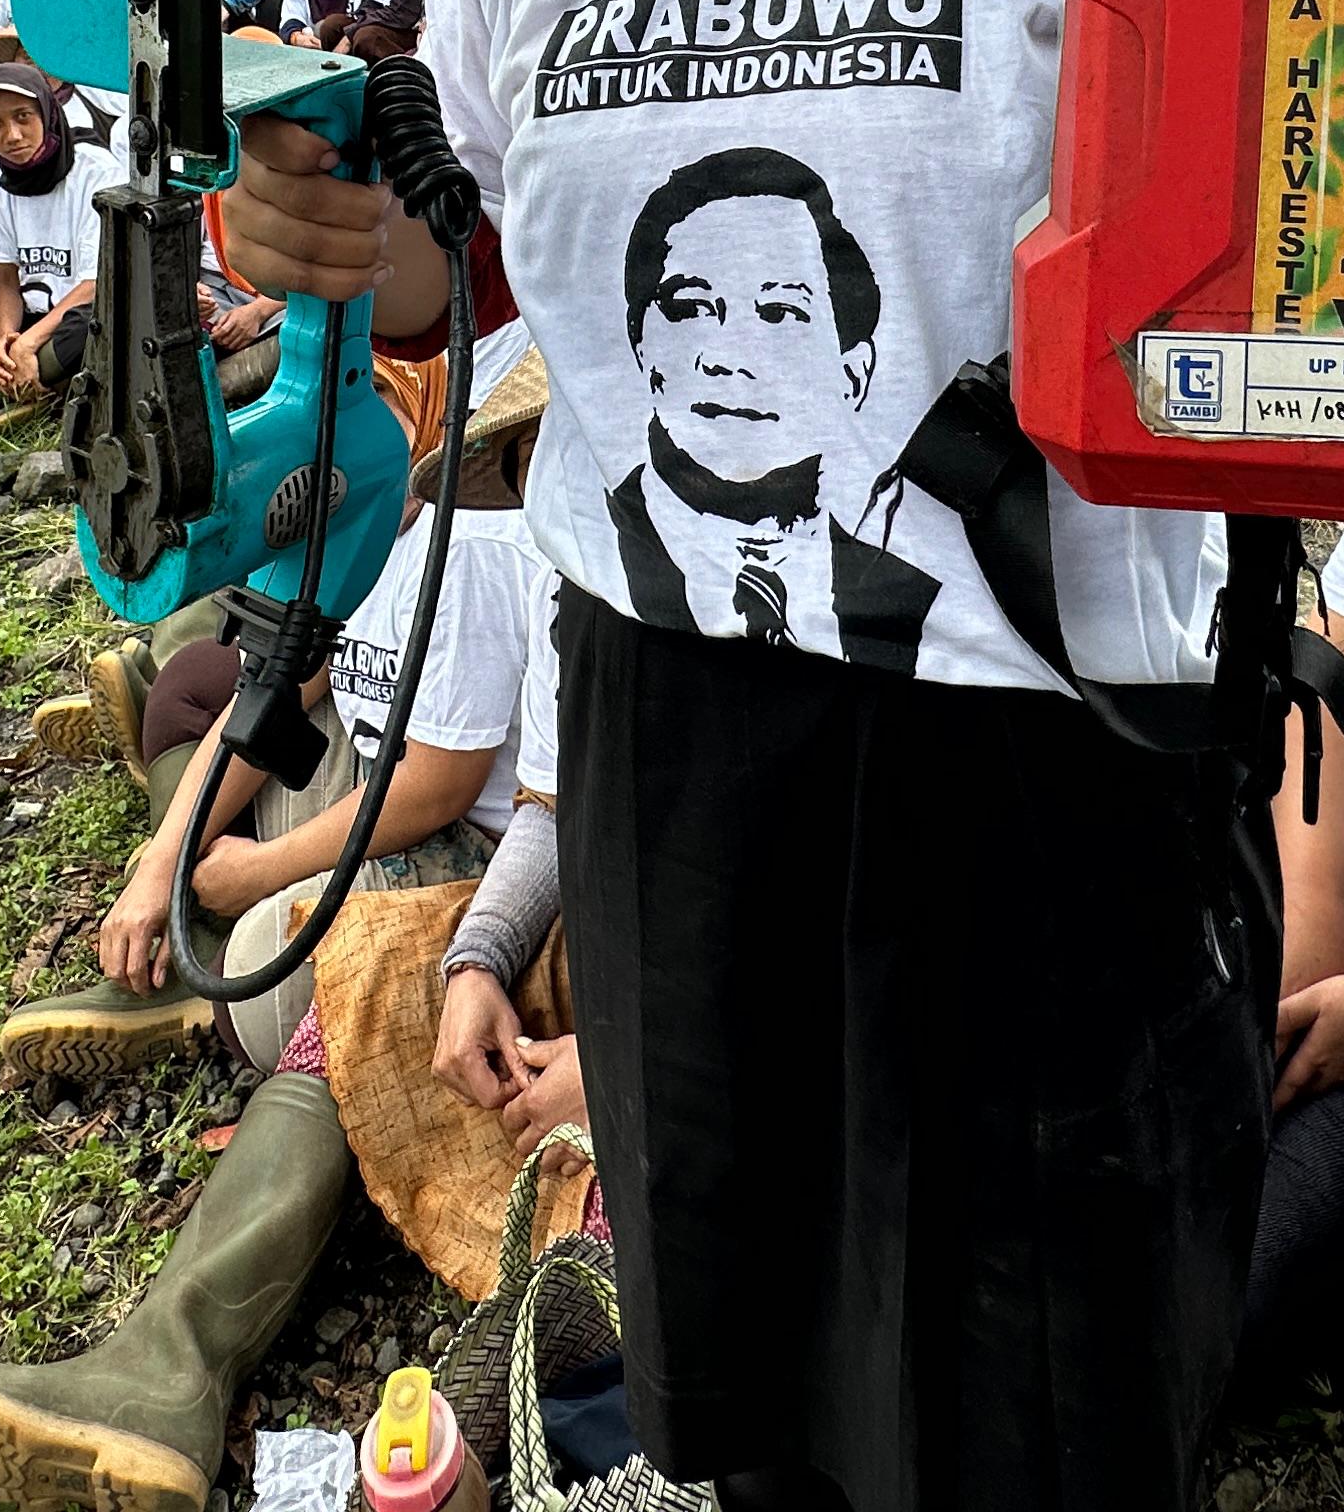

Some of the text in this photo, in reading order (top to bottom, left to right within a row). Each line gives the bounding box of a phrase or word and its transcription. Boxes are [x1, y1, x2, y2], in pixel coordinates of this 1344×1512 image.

[542, 40, 941, 112] UNTUK INDONESIA
[1273, 57, 1320, 334] HARVESTE
[1308, 358, 1337, 375] UP
[1171, 405, 1217, 418] TAMBI
